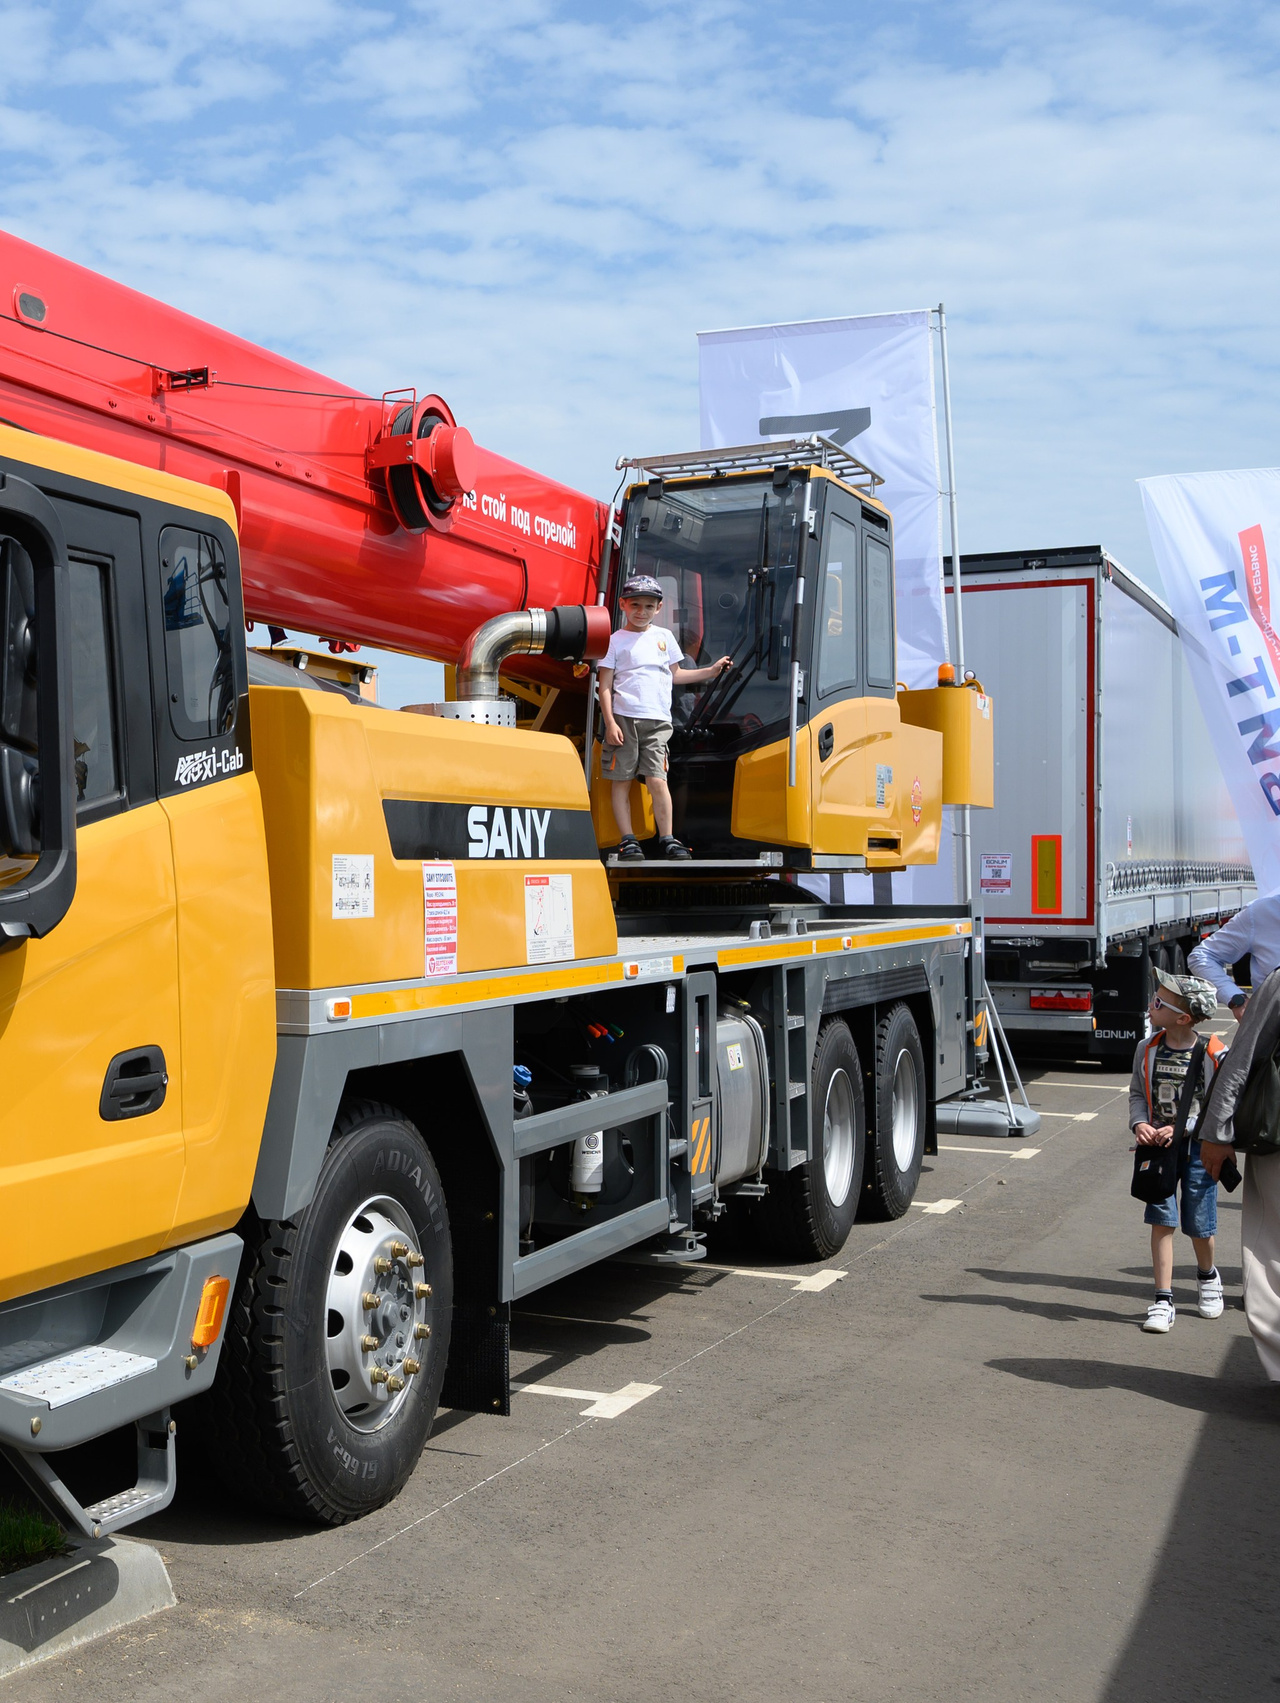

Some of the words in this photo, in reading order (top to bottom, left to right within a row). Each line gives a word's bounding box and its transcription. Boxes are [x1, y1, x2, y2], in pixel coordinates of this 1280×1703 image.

[482, 493, 507, 522] стой
[511, 506, 530, 536] под
[535, 516, 576, 549] стрелой!
[467, 806, 551, 858] SANY
[1095, 1030, 1136, 1039] BONUM
